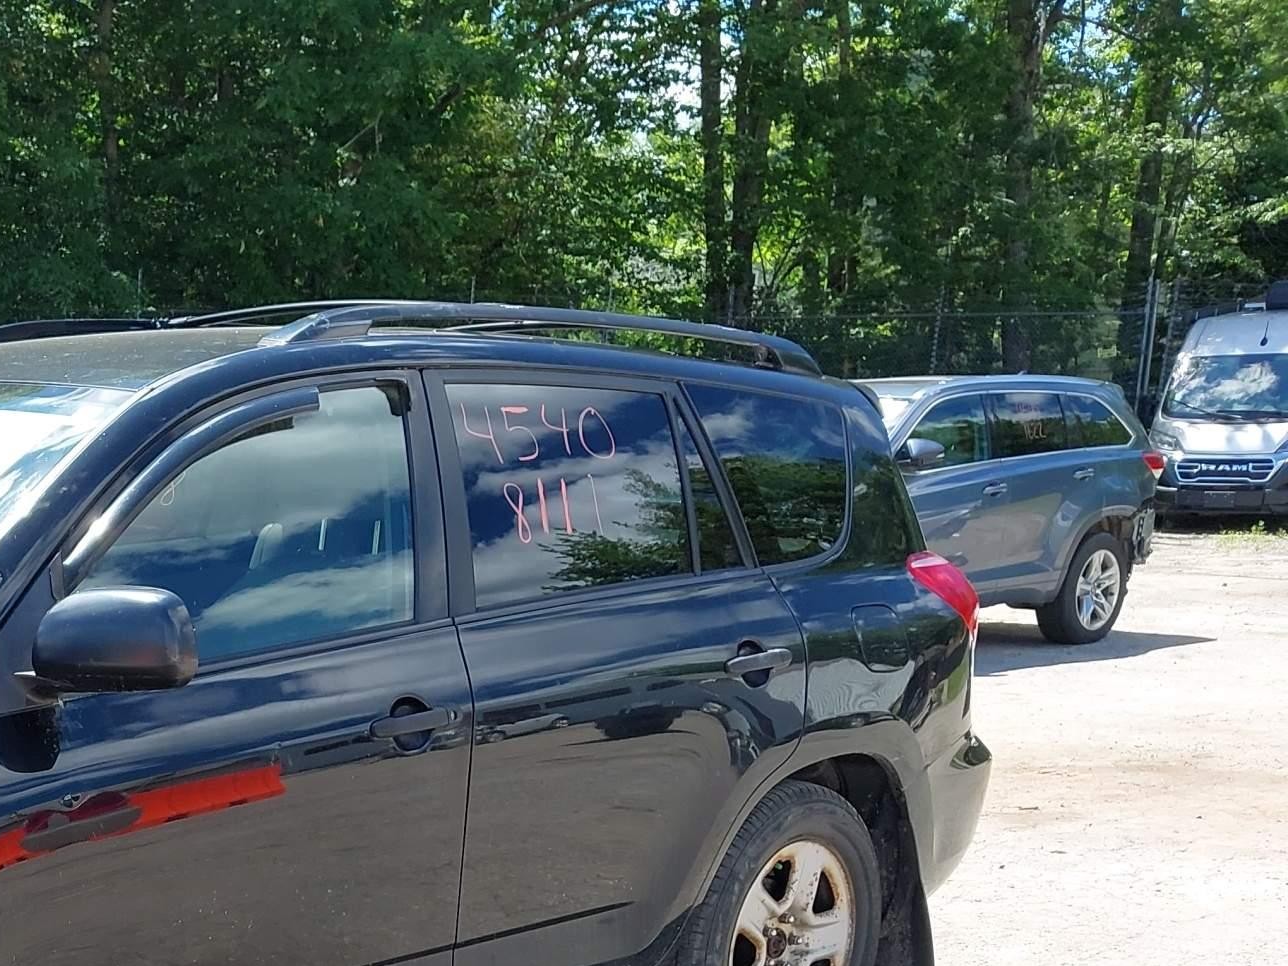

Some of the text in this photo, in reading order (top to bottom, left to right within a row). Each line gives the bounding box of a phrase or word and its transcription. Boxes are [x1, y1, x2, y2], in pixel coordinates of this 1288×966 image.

[459, 402, 617, 465] 4540
[1200, 463, 1249, 472] RAM
[502, 473, 605, 545] 8111
